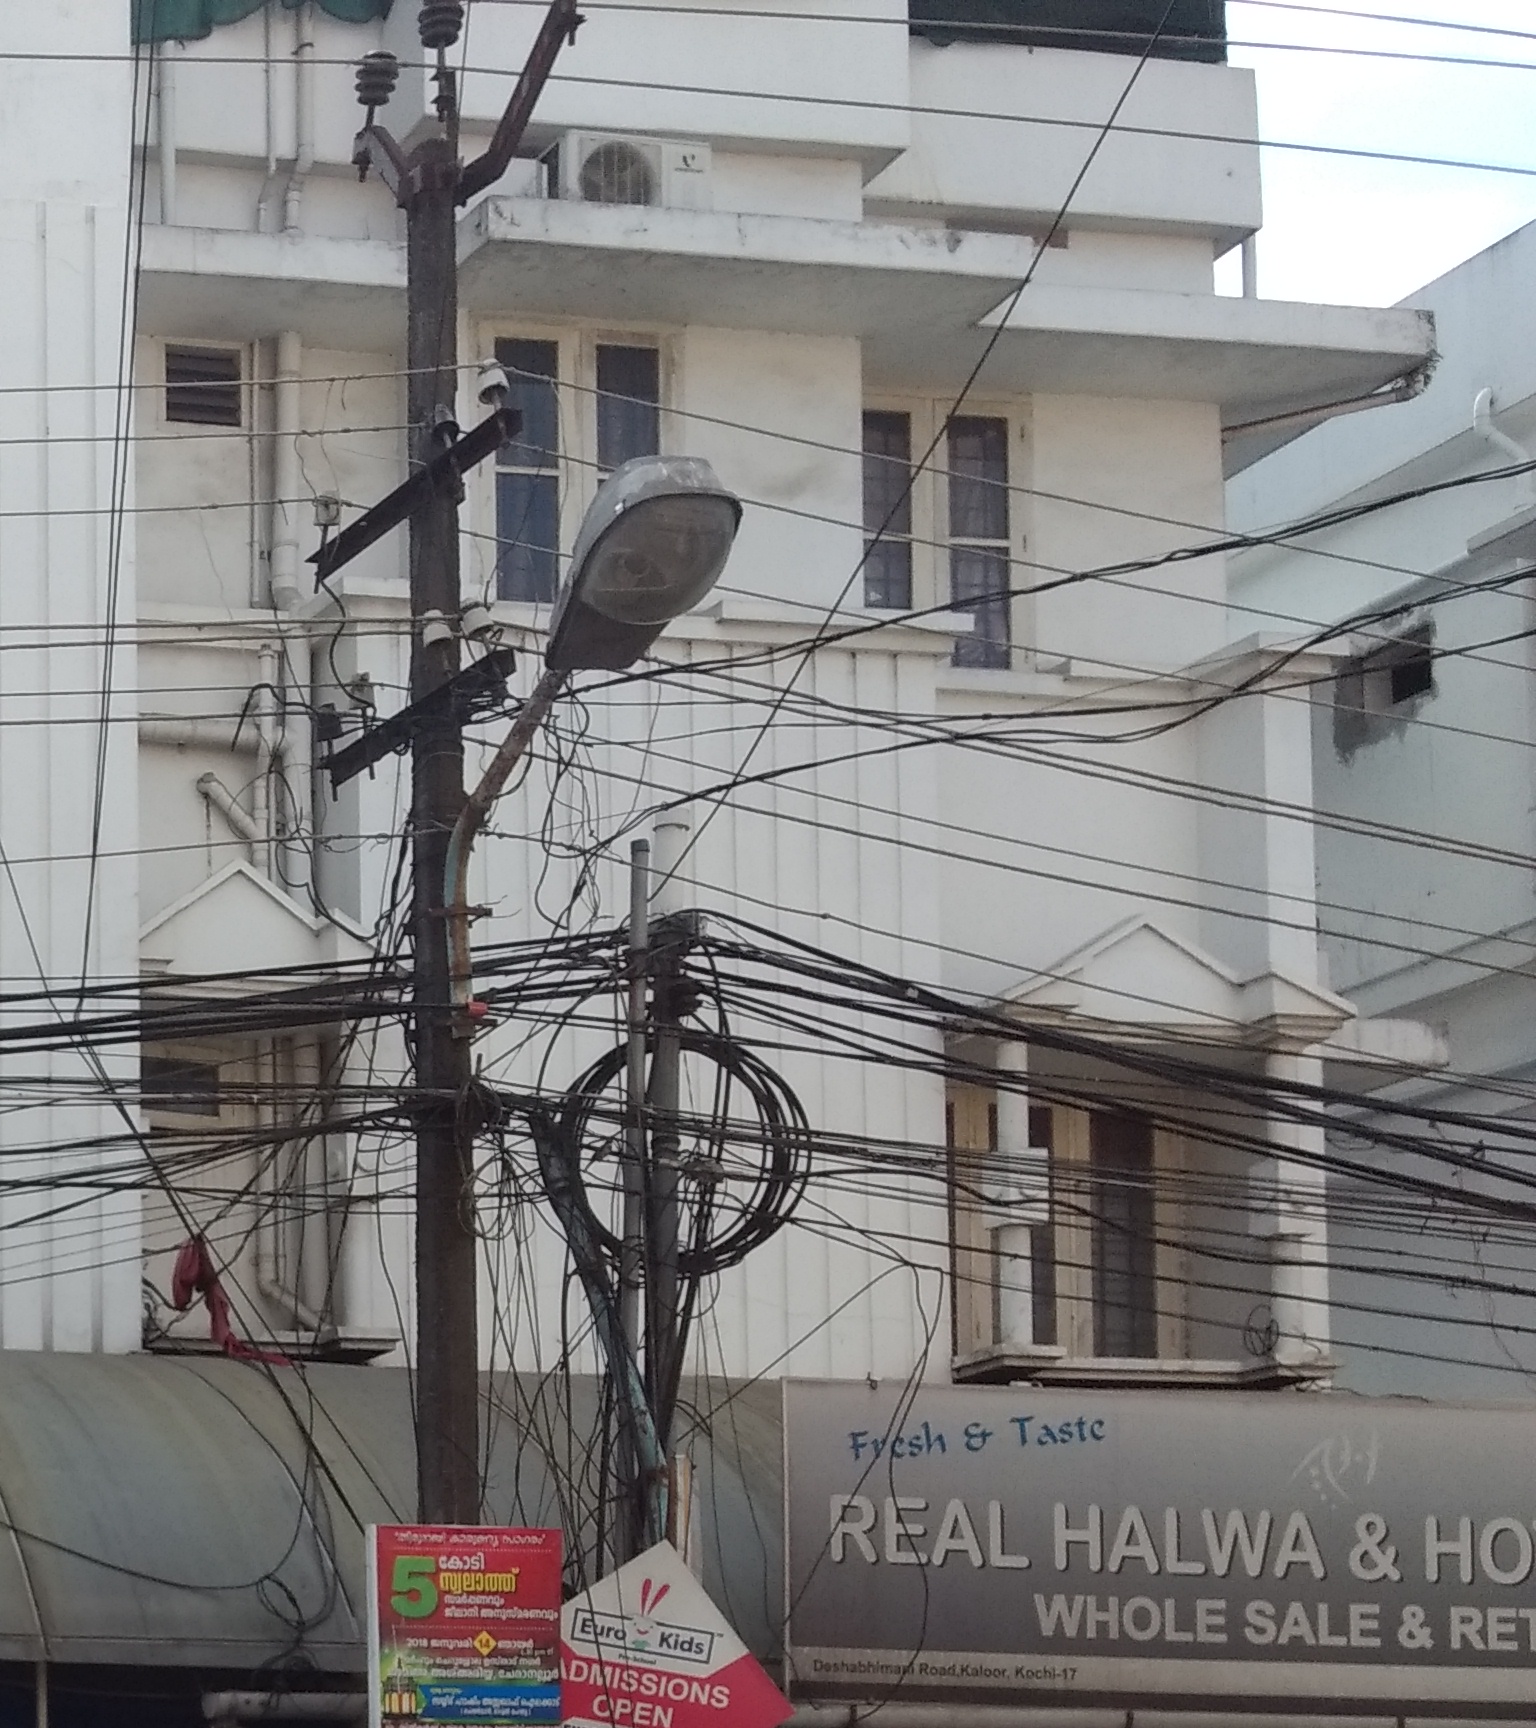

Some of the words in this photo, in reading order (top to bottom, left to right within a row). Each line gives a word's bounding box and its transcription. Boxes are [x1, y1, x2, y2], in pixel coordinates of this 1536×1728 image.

[848, 1421, 947, 1461] Fresh
[964, 1422, 993, 1451] &
[1009, 1415, 1106, 1447] Taste
[829, 1493, 1030, 1571] REAL
[1053, 1501, 1328, 1582] HALWA
[1349, 1512, 1404, 1583] &
[1425, 1515, 1536, 1586] HO
[438, 1552, 485, 1570] കോടി
[439, 1566, 520, 1595] സ്വലാത്ത്
[391, 1555, 438, 1618] 5
[580, 1617, 627, 1641] Euro
[658, 1631, 705, 1655] Kids
[1033, 1593, 1228, 1644] WHOLE
[1244, 1600, 1381, 1648] SALE
[1397, 1603, 1434, 1650] &
[592, 1694, 674, 1728] OPEN
